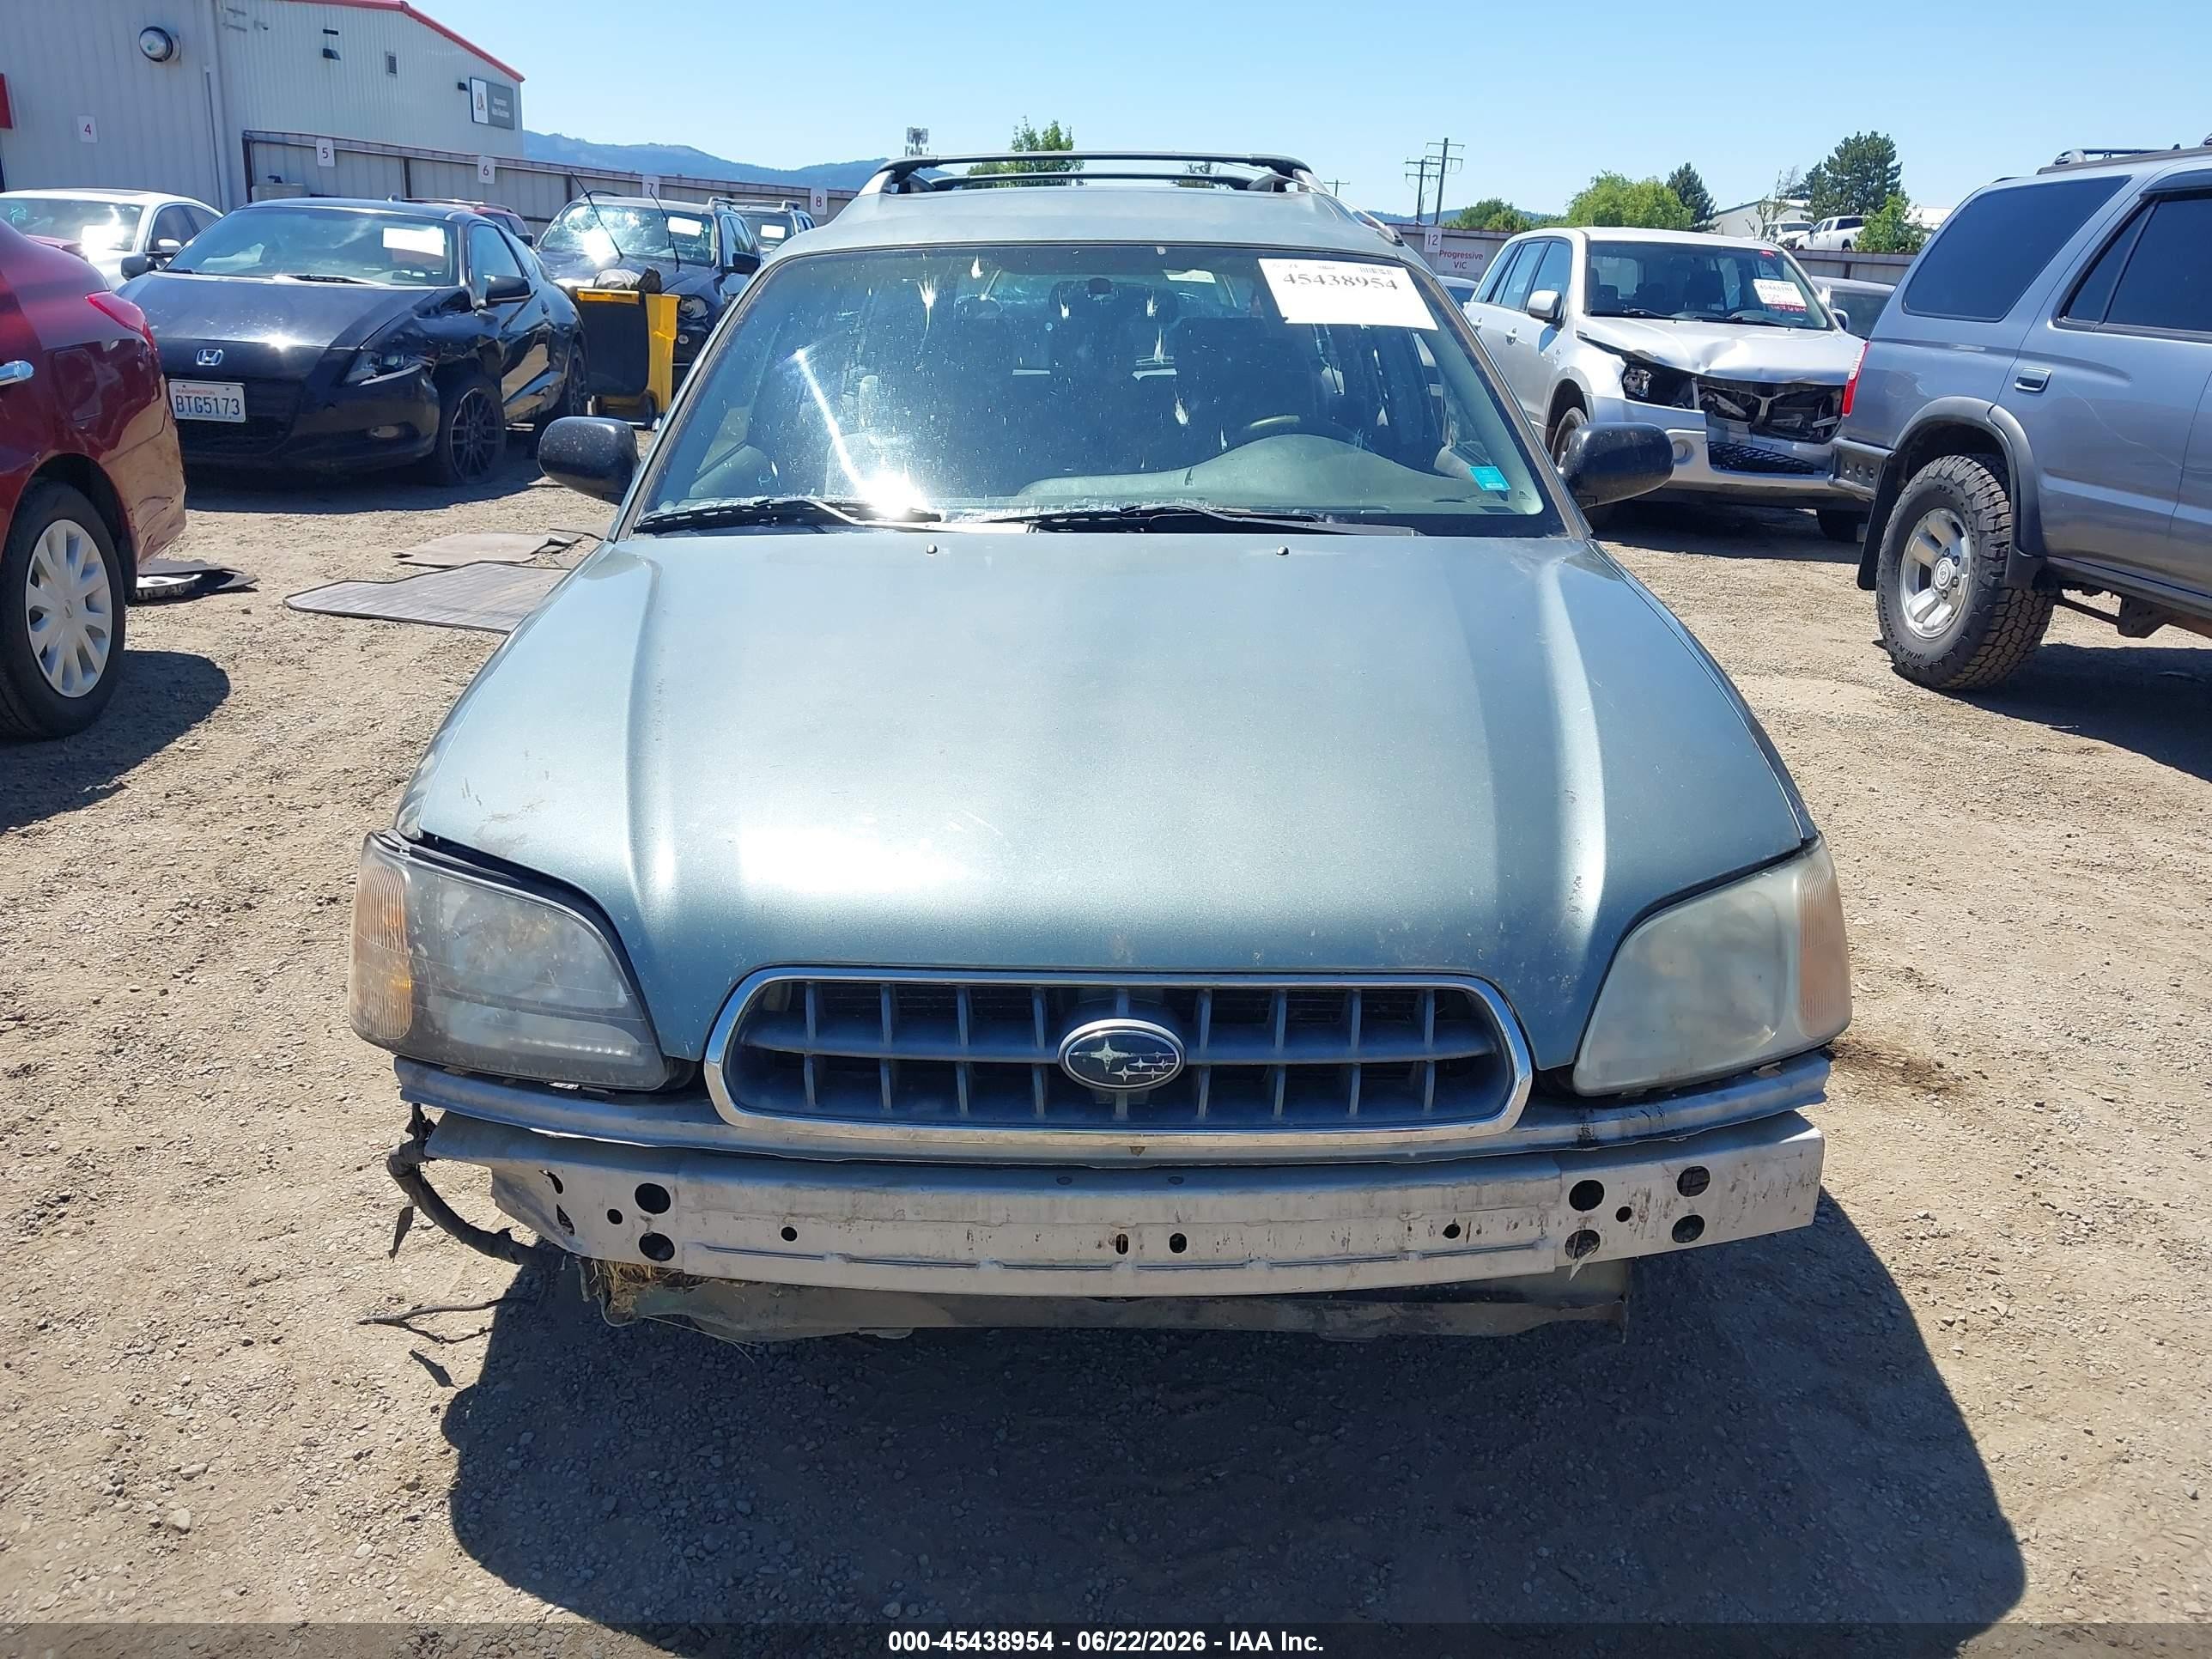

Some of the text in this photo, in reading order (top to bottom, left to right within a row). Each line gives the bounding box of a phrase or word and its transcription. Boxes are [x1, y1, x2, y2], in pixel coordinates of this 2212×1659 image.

[84, 124, 91, 136] 4
[322, 147, 328, 159] 5
[483, 165, 489, 176] 6
[816, 196, 822, 207] 8
[1427, 234, 1439, 246] 12
[1438, 249, 1484, 260] Progressive
[1453, 261, 1468, 270] VIC
[1283, 273, 1398, 290] 45438954
[175, 395, 240, 416] BTG5173
